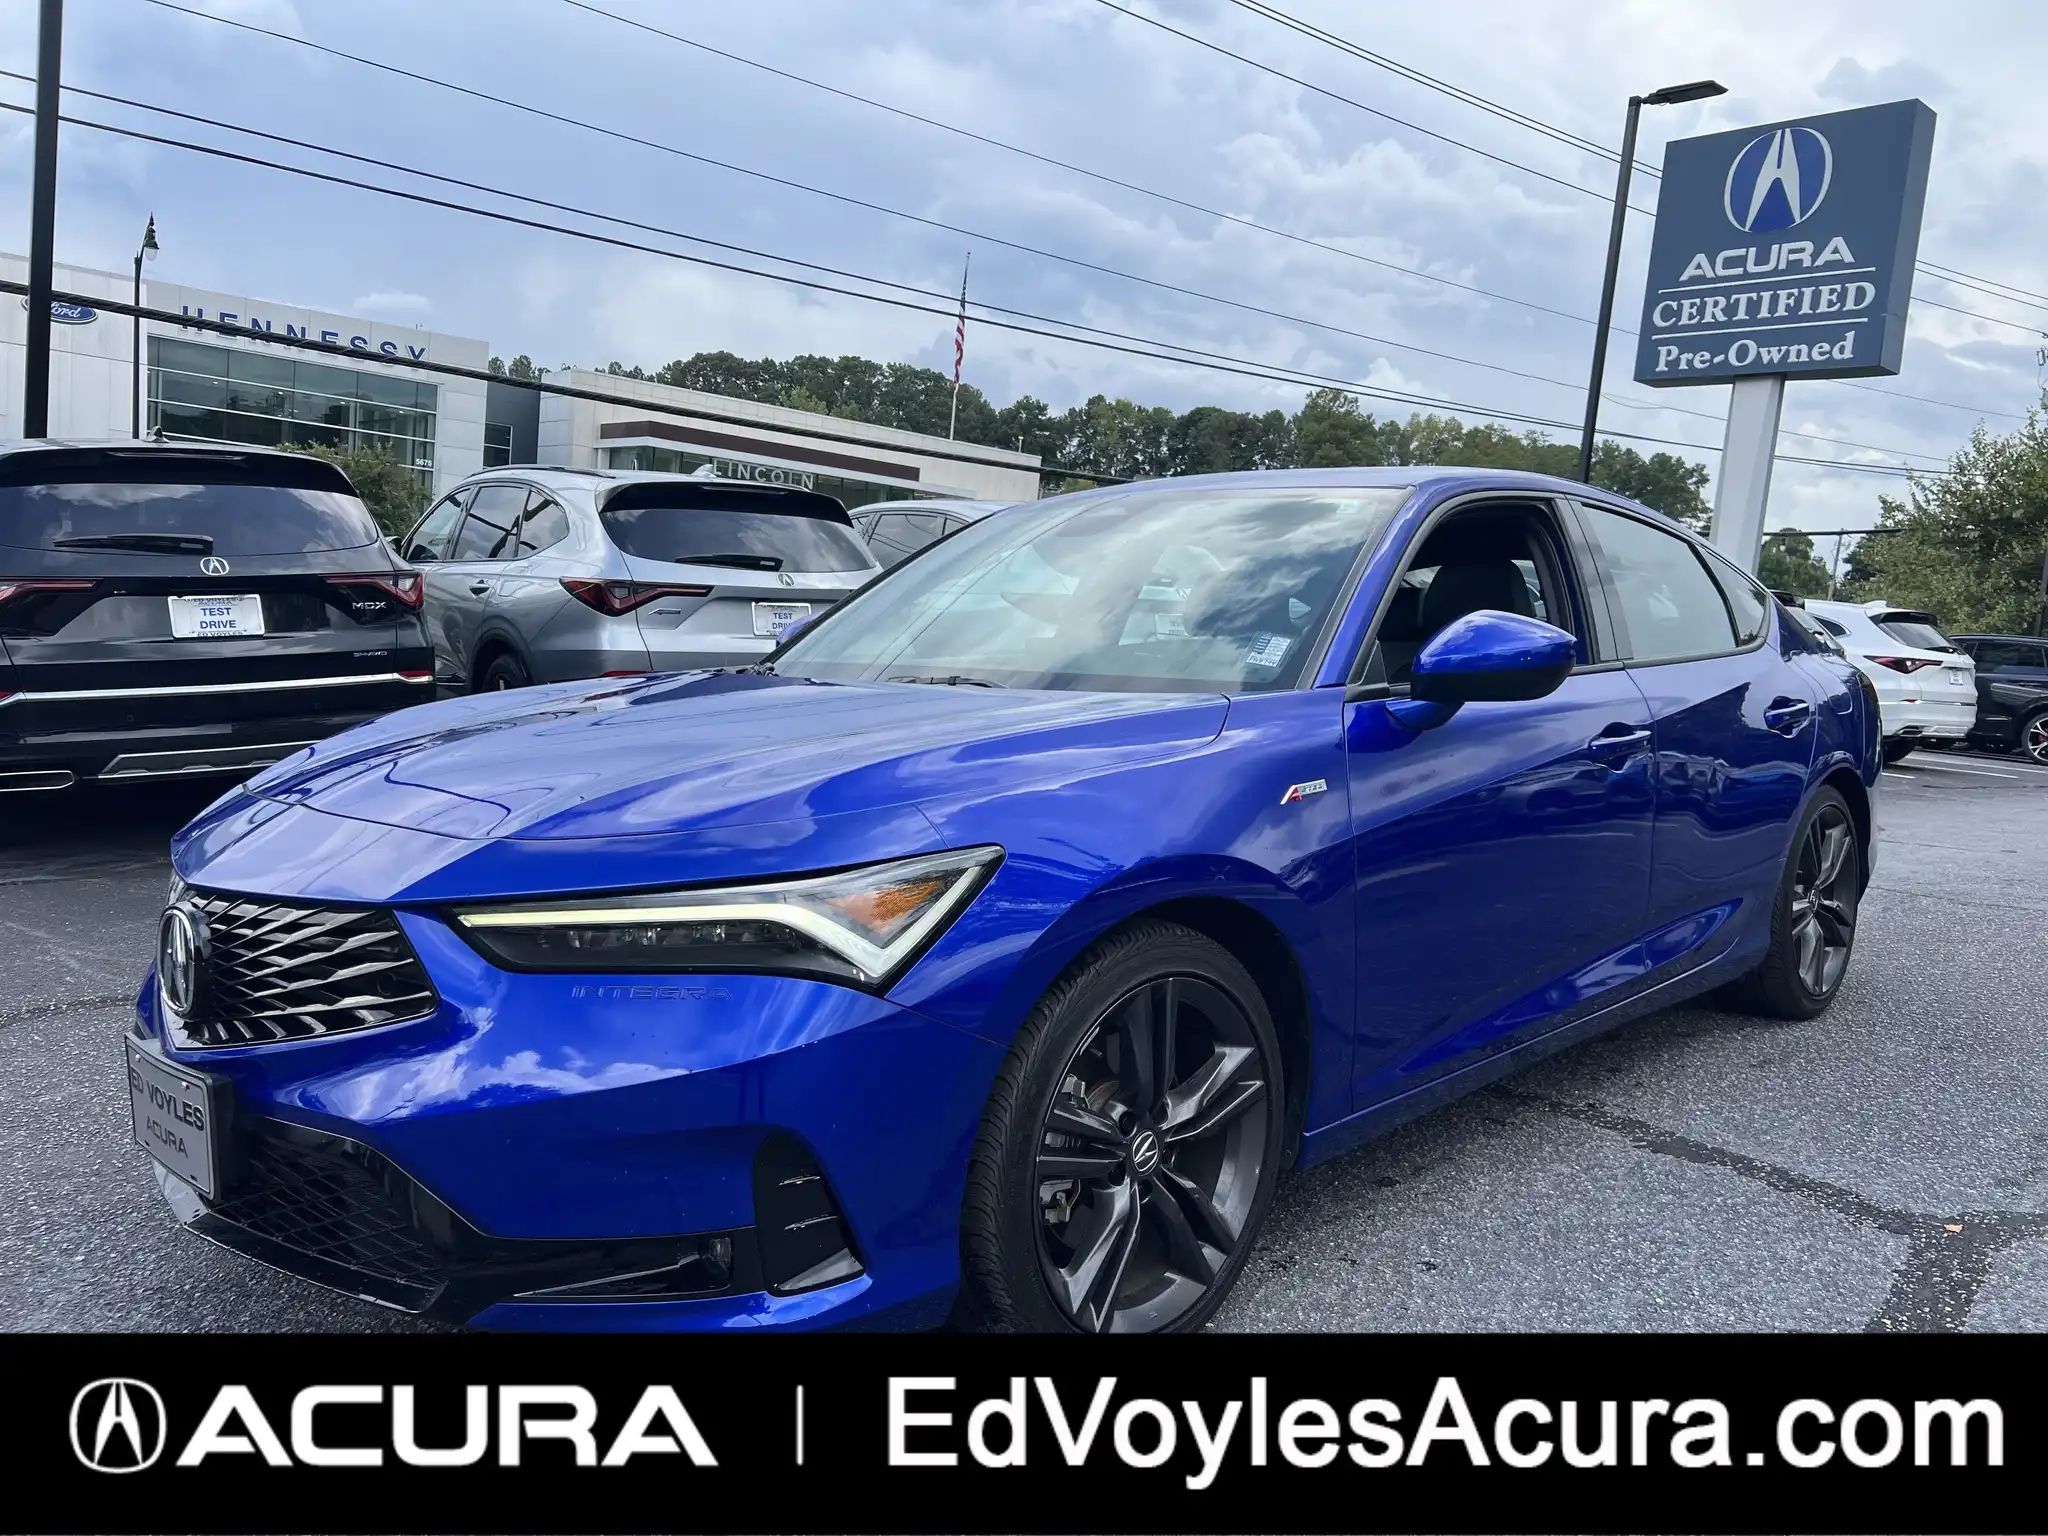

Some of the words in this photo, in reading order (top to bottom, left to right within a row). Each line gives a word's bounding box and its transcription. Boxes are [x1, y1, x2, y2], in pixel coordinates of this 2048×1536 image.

[1678, 236, 1855, 282] ACURA
[1652, 281, 1876, 329] CERTIFIED
[182, 305, 427, 370] HENNESSY
[1655, 330, 1856, 372] Pre-Owned
[199, 620, 237, 629] DRIVE
[200, 607, 232, 616] TEST
[352, 601, 387, 610] MDX
[773, 612, 793, 620] TEST
[571, 985, 733, 1000] INTEGRA
[130, 1066, 144, 1095] ED
[146, 1080, 204, 1131] VOYLES
[146, 1115, 189, 1159] ACURA
